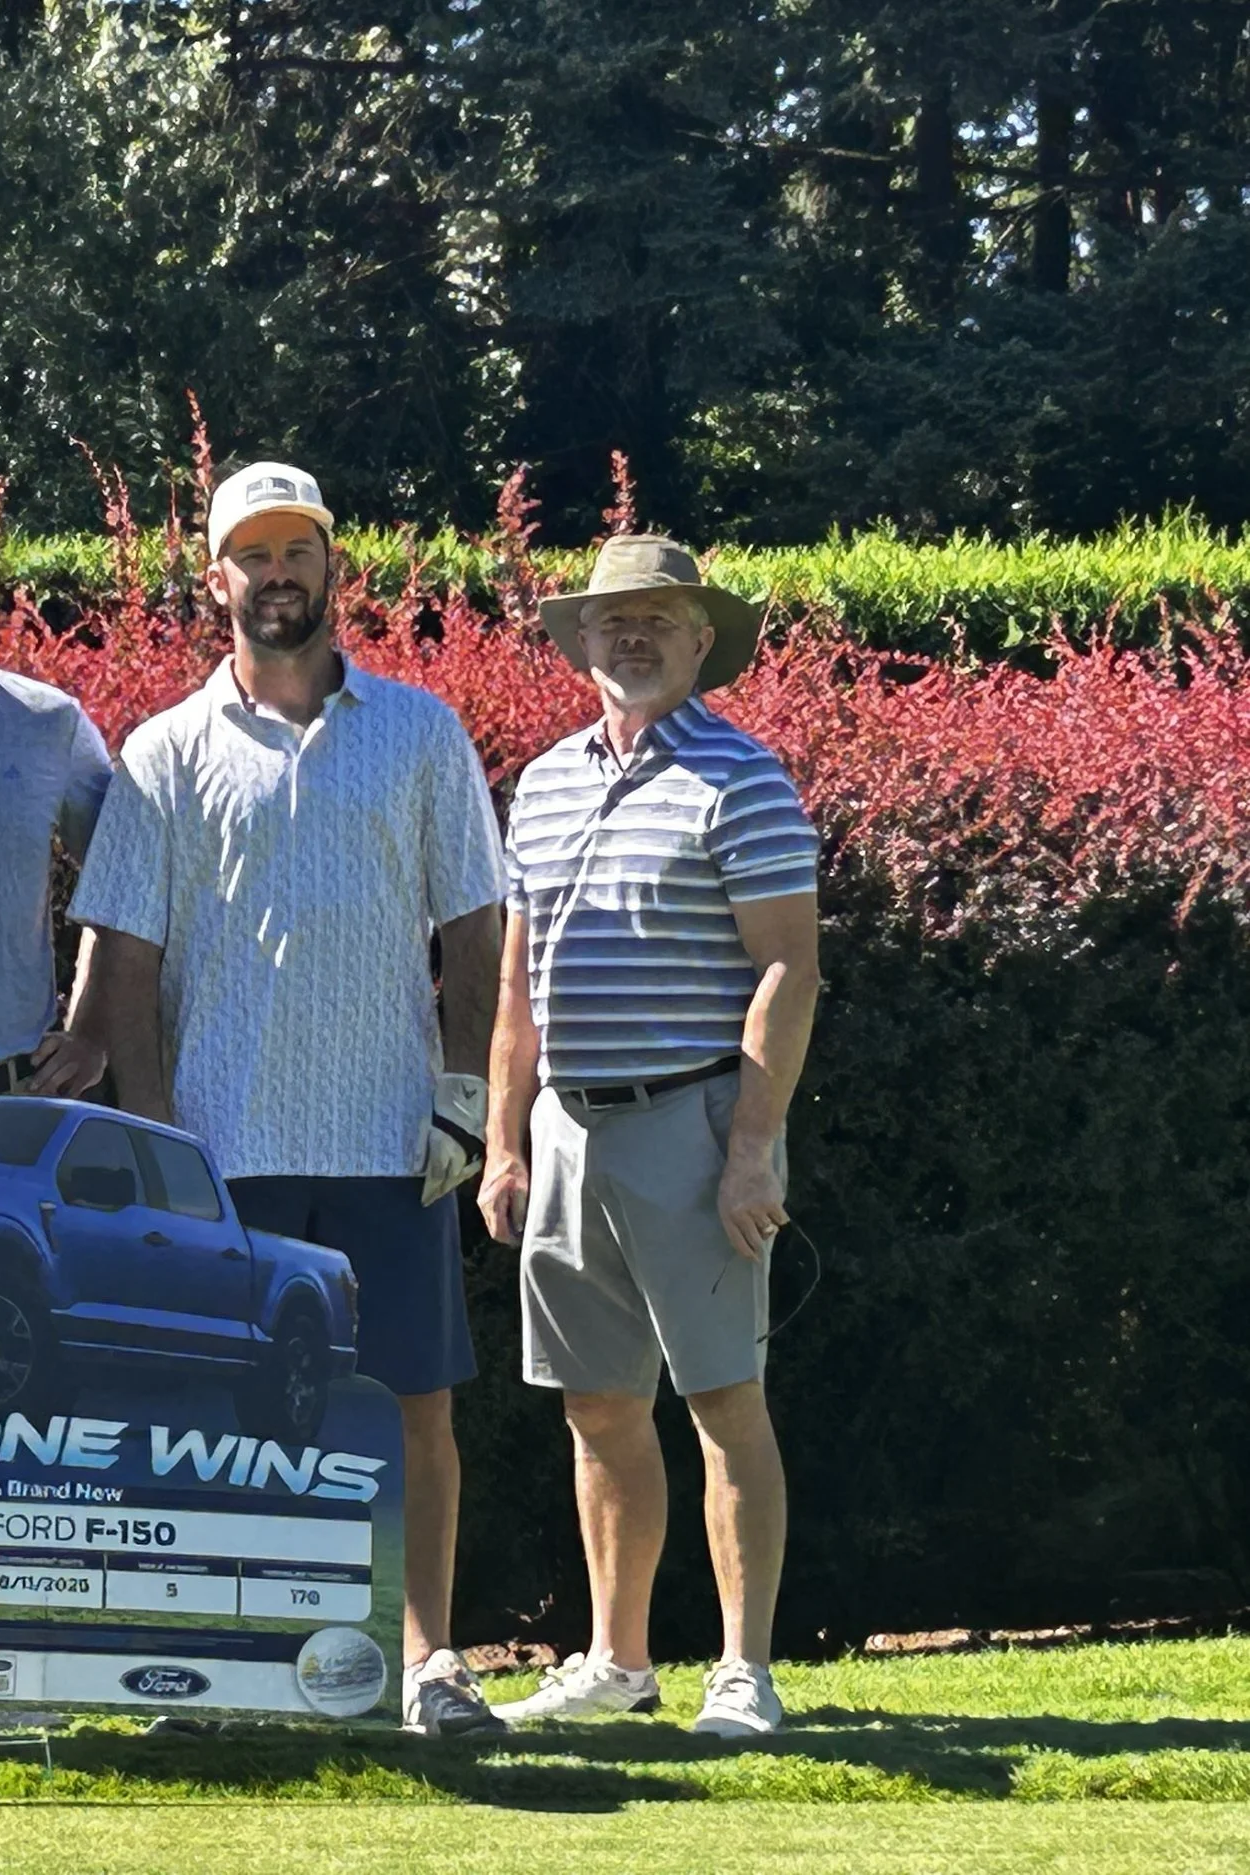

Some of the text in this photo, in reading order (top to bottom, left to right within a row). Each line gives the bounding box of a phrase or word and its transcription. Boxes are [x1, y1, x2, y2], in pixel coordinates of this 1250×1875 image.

[150, 1424, 388, 1503] WINS
[7, 1479, 70, 1499] Brand
[75, 1482, 124, 1502] New
[85, 1517, 177, 1547] F-150
[138, 1668, 191, 1694] Ford
